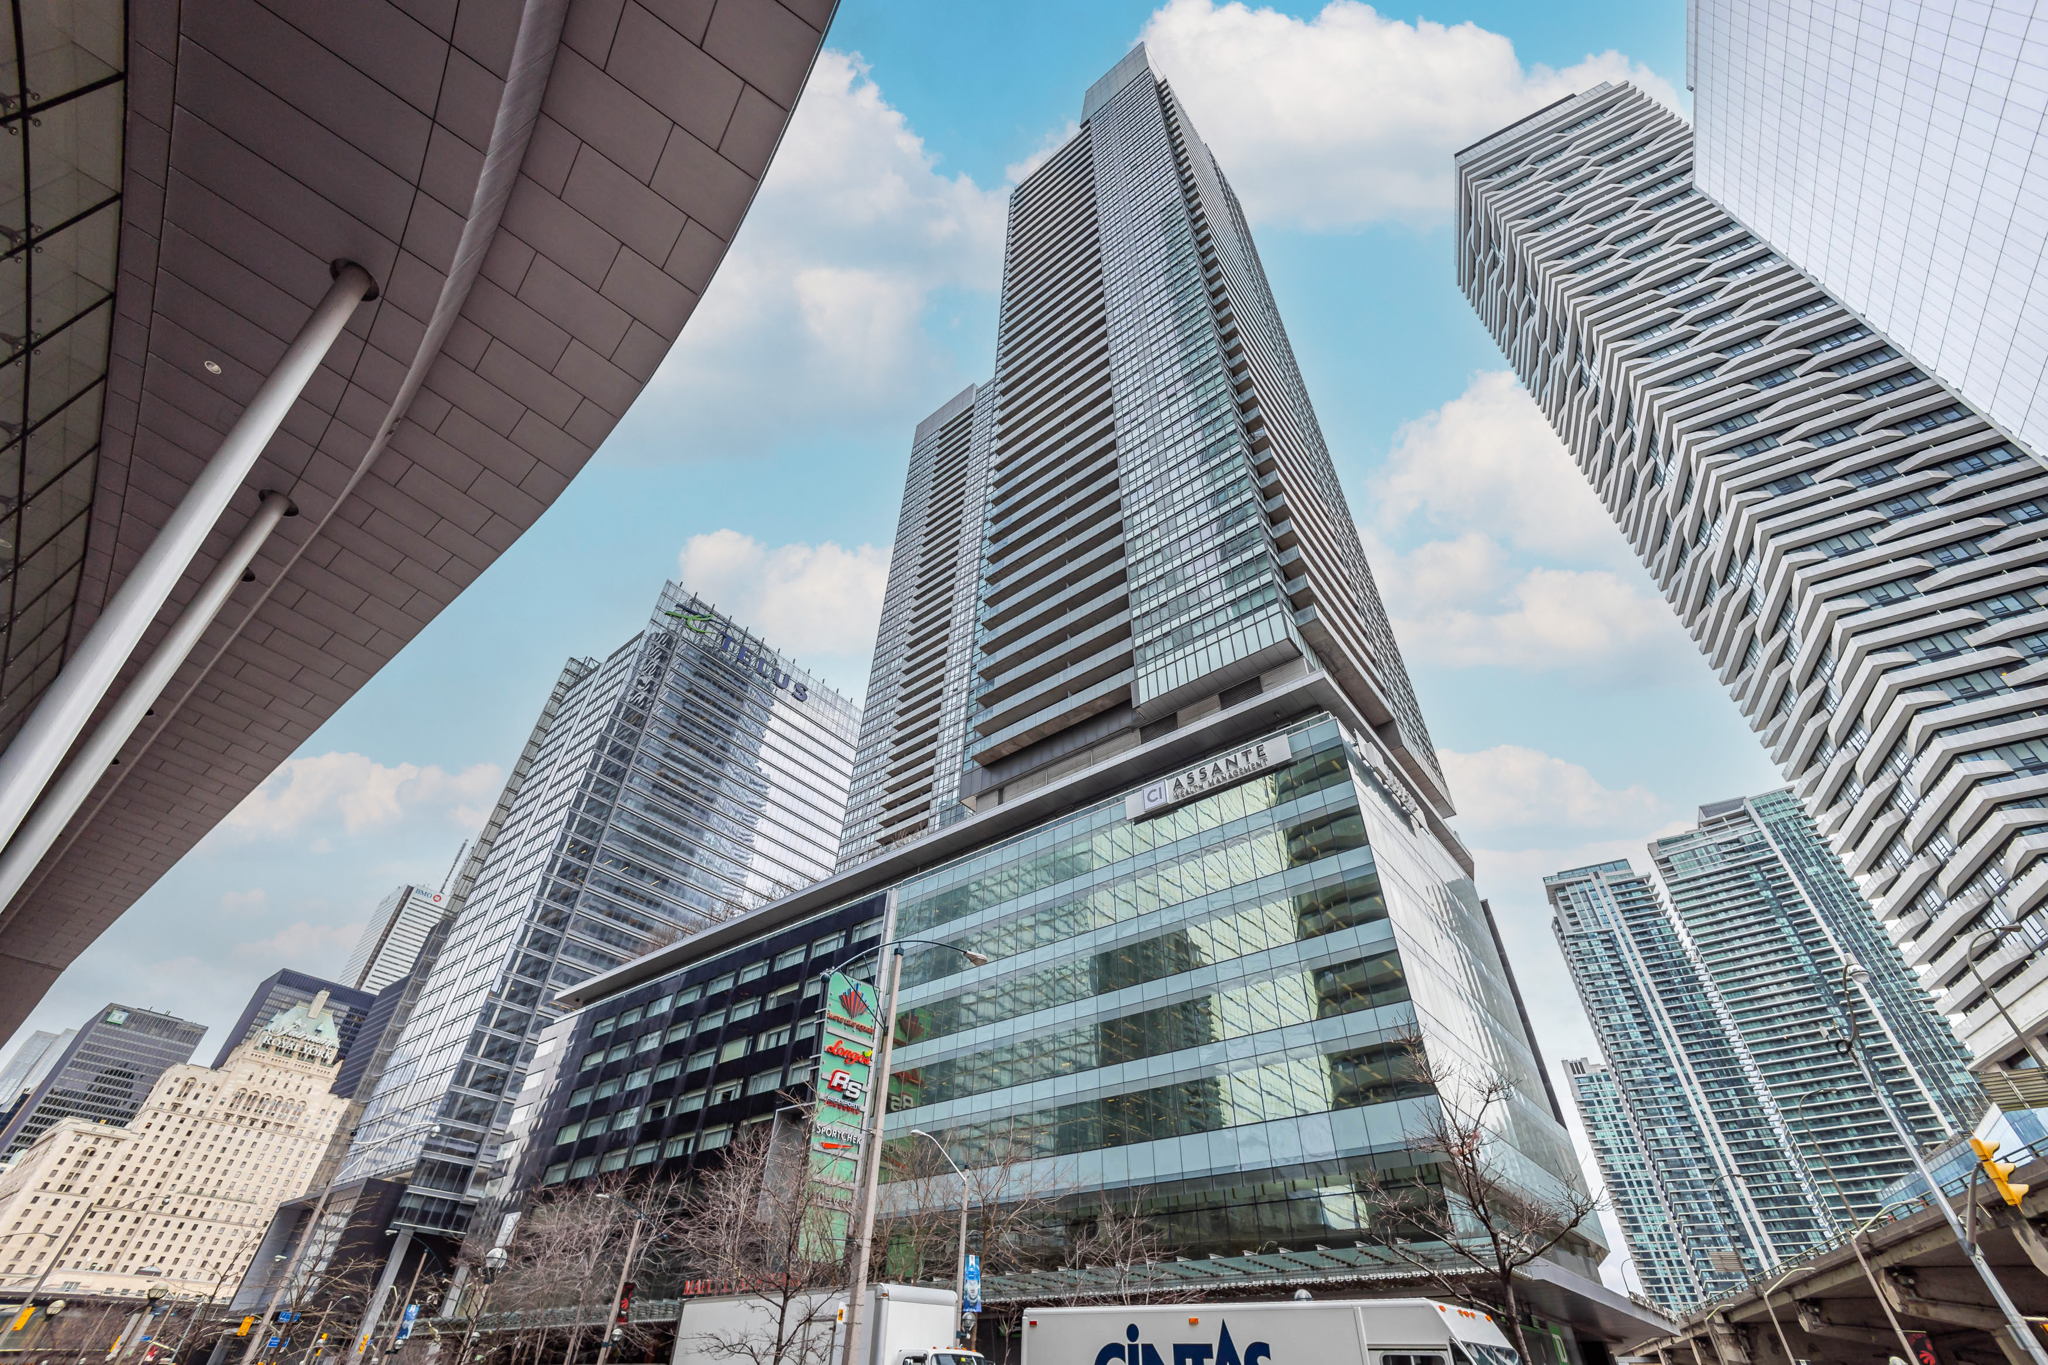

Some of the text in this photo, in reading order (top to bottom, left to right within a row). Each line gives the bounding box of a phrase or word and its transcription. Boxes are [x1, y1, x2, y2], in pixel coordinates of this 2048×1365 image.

[717, 630, 808, 702] TELUS
[1173, 744, 1266, 791] ASSANTE
[1173, 758, 1268, 800] WEALTH MANAGEMENT
[1147, 787, 1162, 803] CI
[262, 1035, 333, 1059] ROYAL YORK
